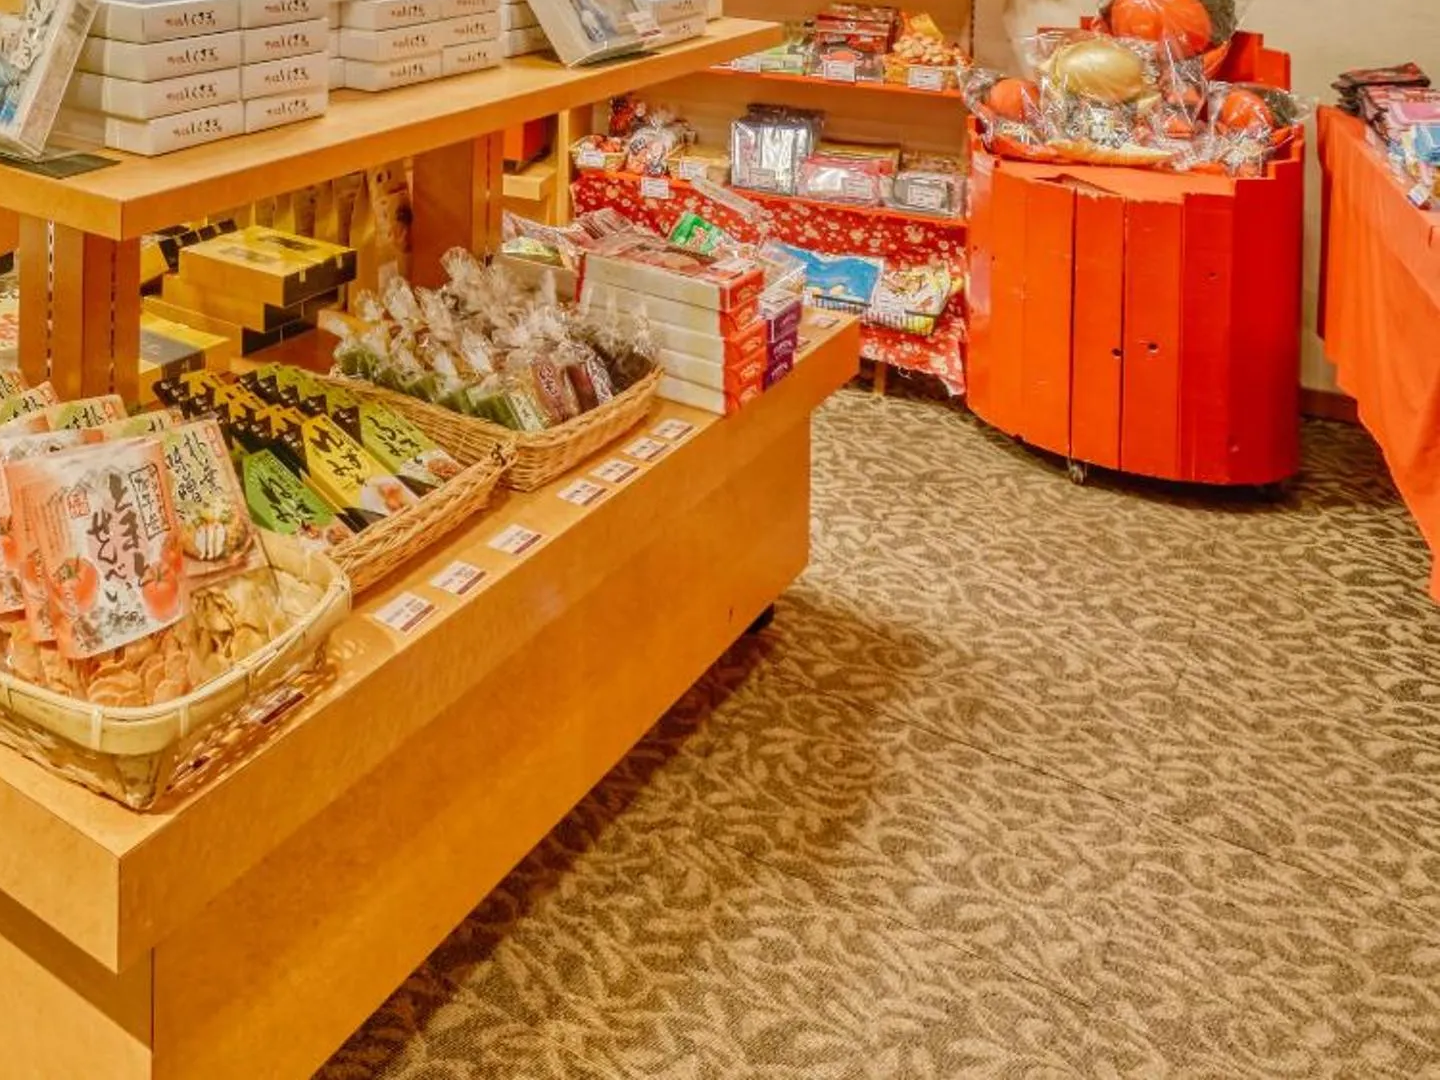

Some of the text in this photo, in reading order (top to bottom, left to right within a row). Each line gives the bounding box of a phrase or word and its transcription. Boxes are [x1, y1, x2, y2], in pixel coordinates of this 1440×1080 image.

[87, 508, 133, 603] せんべい
[109, 473, 152, 588] とまと
